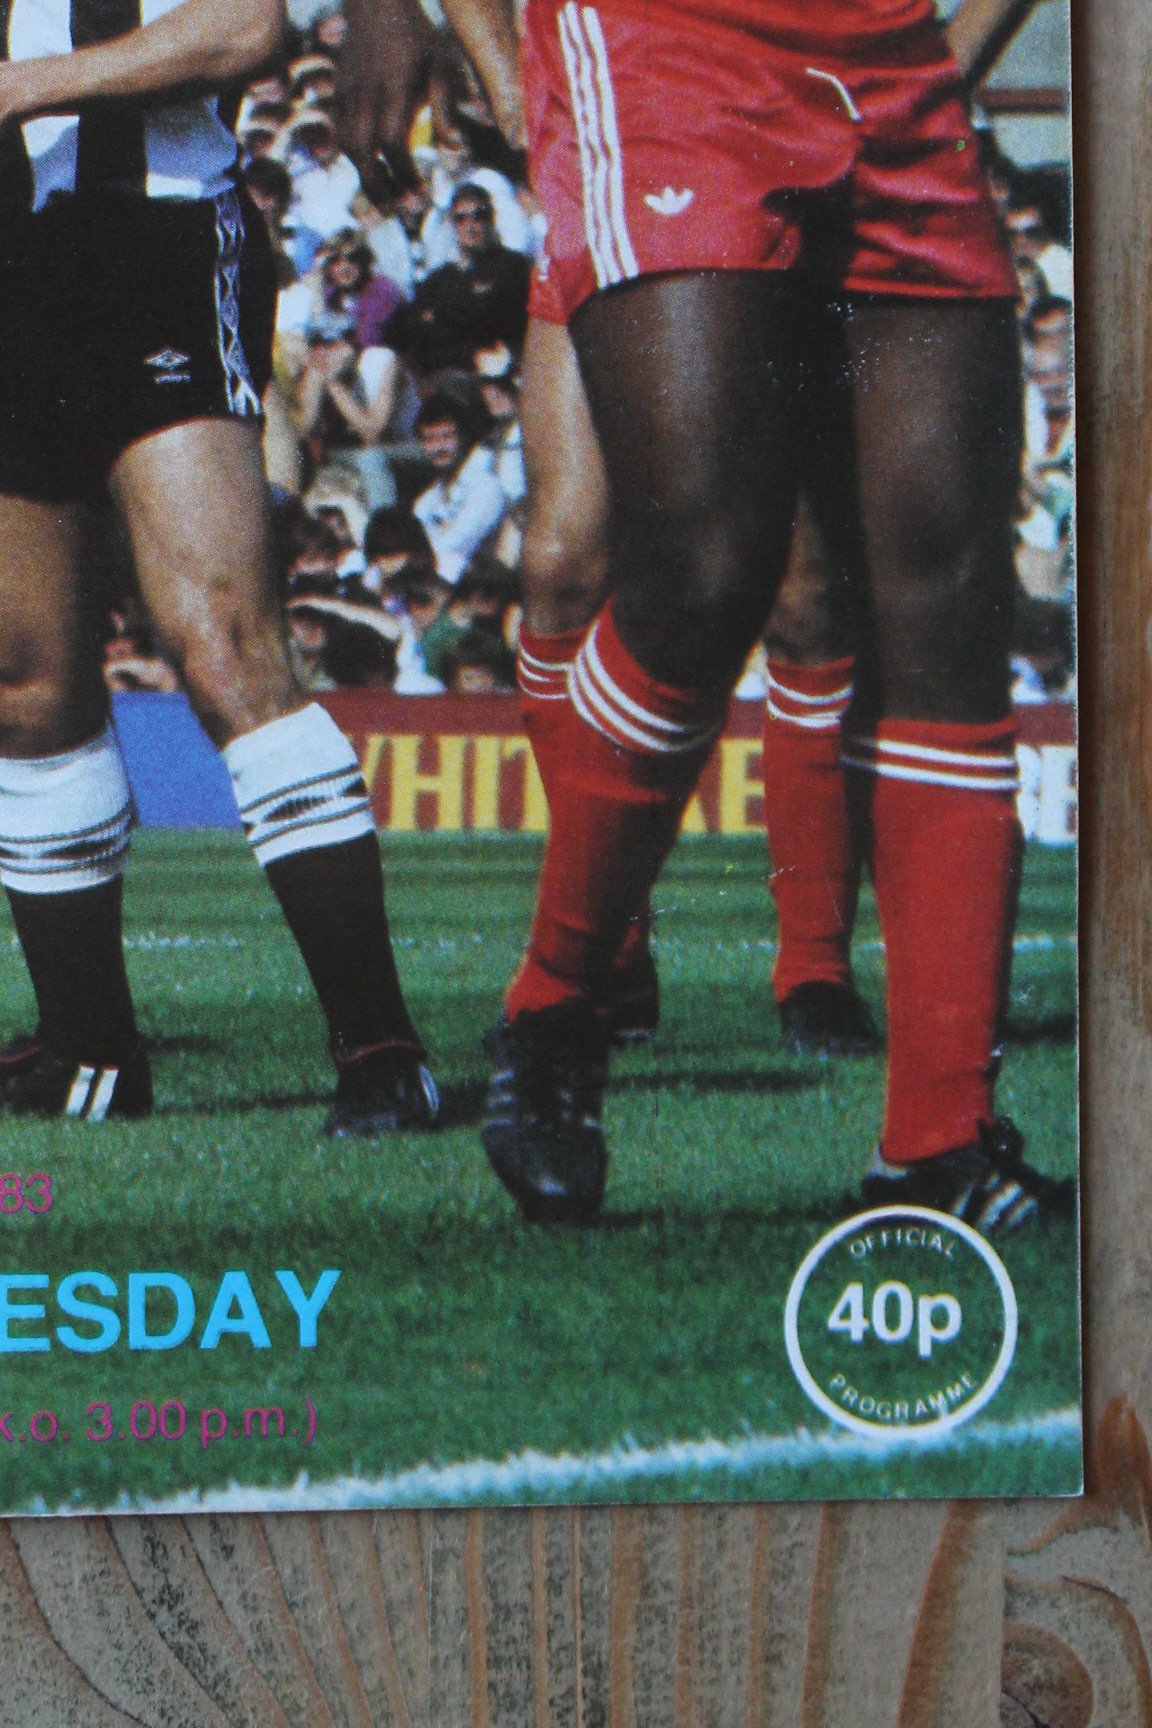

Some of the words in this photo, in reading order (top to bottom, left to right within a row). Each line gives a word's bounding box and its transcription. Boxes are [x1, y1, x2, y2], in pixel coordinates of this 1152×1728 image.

[850, 1228, 956, 1260] OFFICIAL
[827, 1281, 962, 1359] 40p
[829, 1373, 976, 1420] PROGRAMME
[86, 1400, 187, 1441] 3.00
